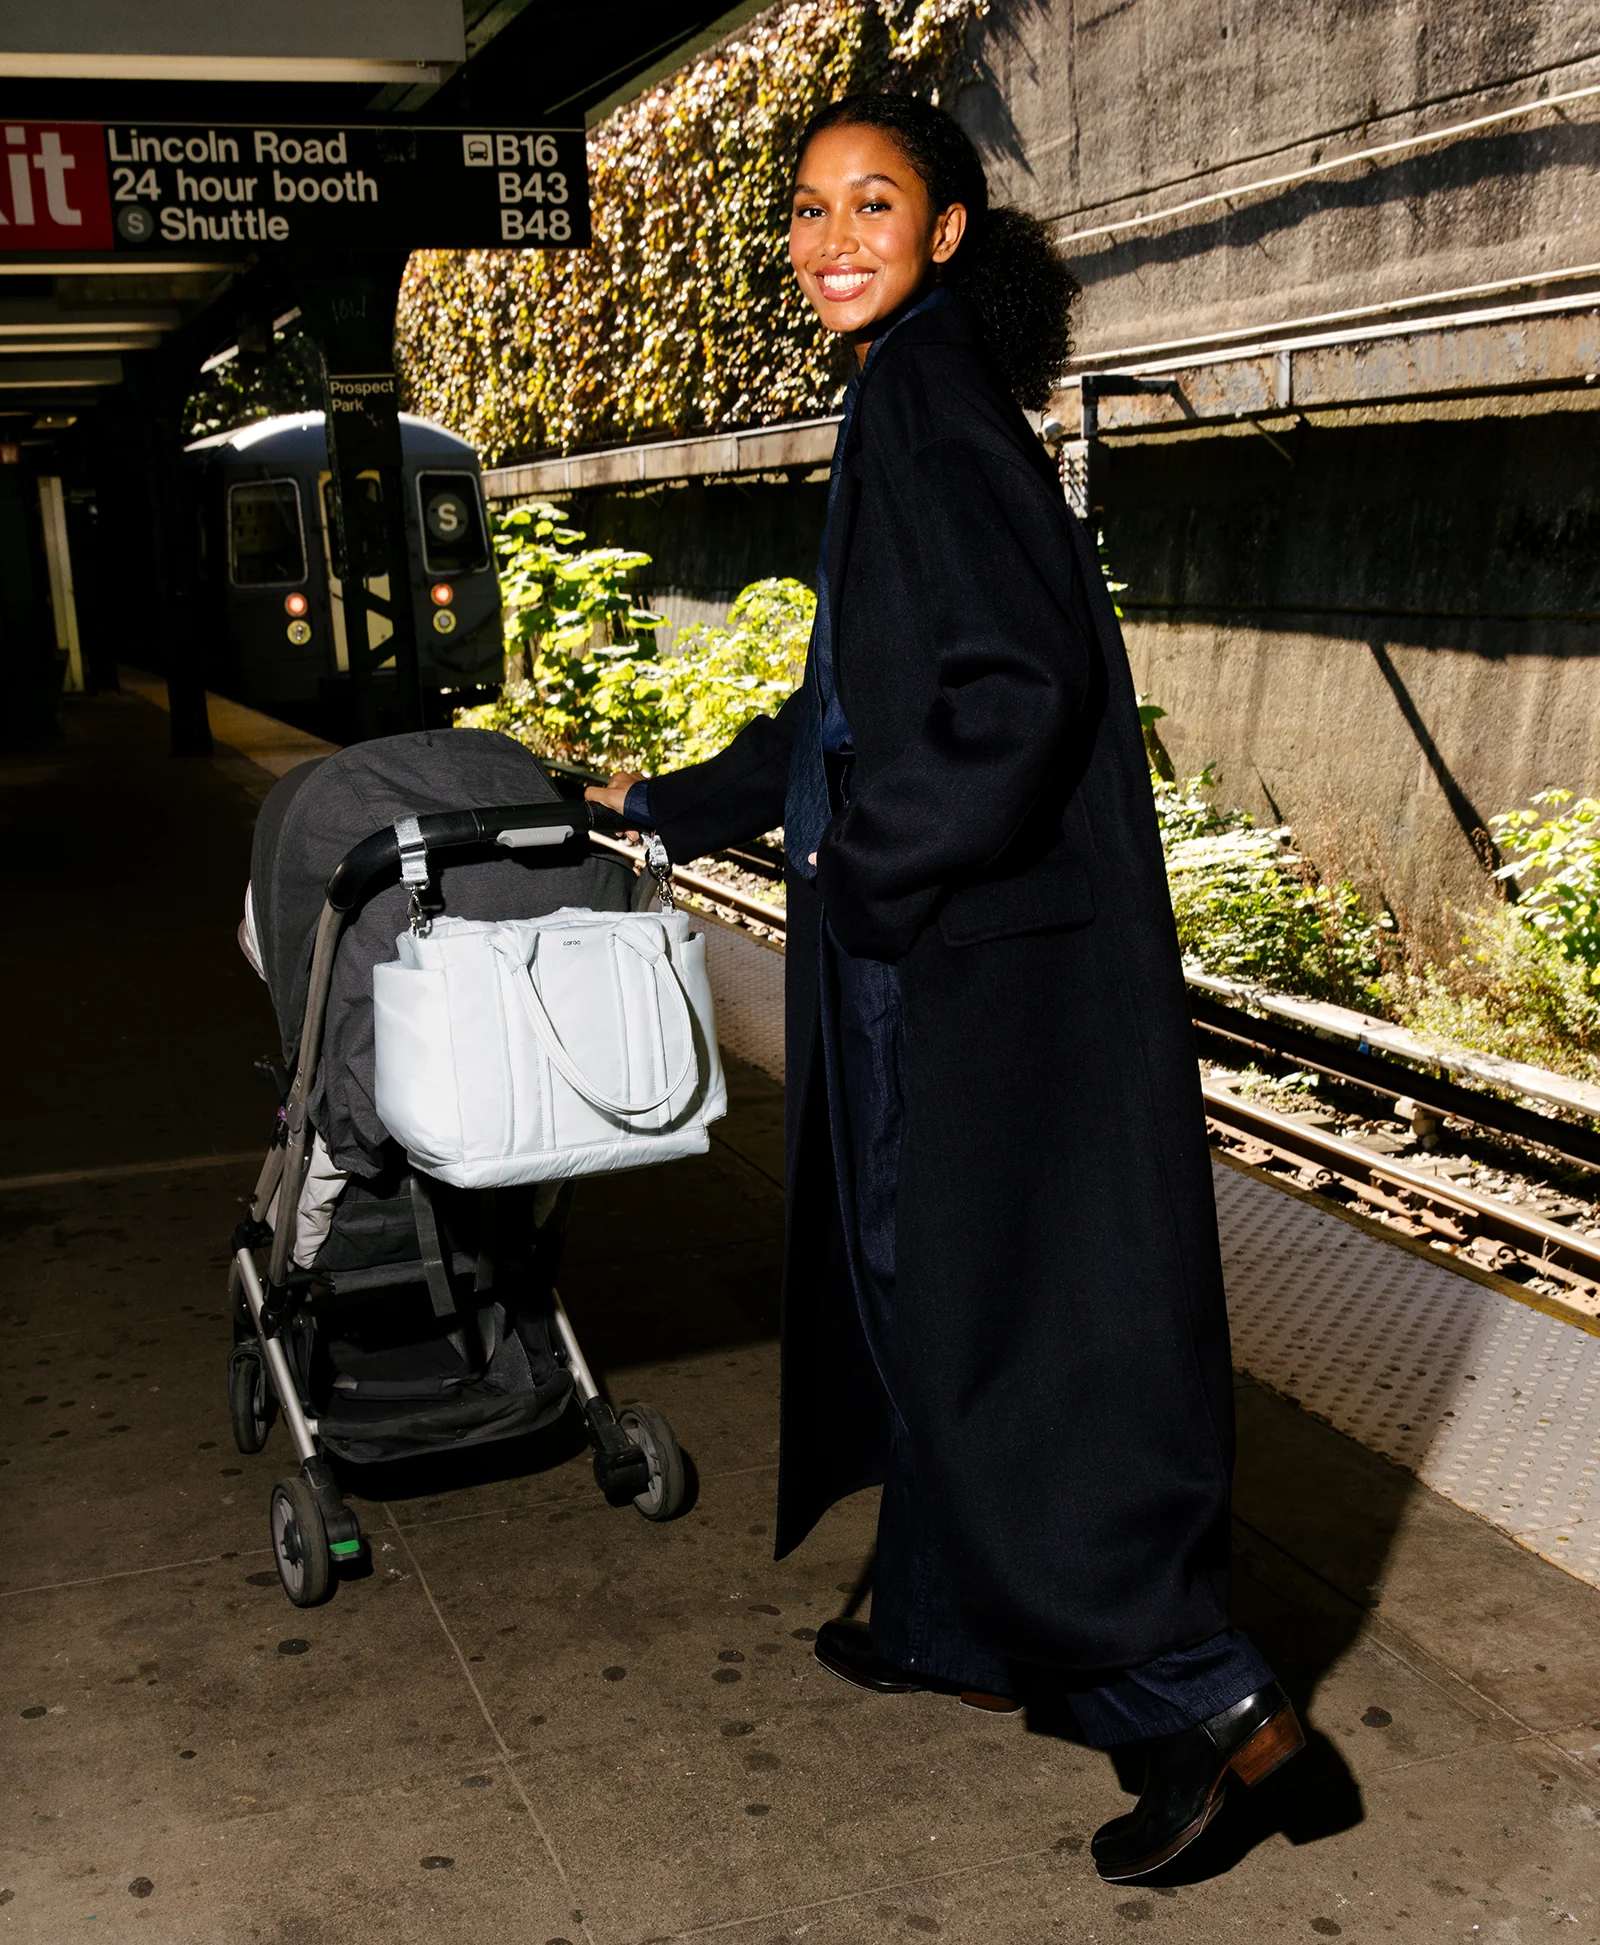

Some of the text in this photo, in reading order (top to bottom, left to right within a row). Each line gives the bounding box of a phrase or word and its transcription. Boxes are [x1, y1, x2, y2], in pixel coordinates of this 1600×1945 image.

[107, 128, 348, 164] Lincoln Road
[496, 134, 559, 168] B16
[0, 126, 82, 226] it
[112, 167, 379, 203] 24 hour booth
[498, 171, 569, 204] B43
[126, 206, 290, 241] S Shuttle
[500, 208, 572, 241] B48
[329, 378, 396, 397] Prospect
[331, 397, 365, 413] Park
[437, 502, 459, 532] S
